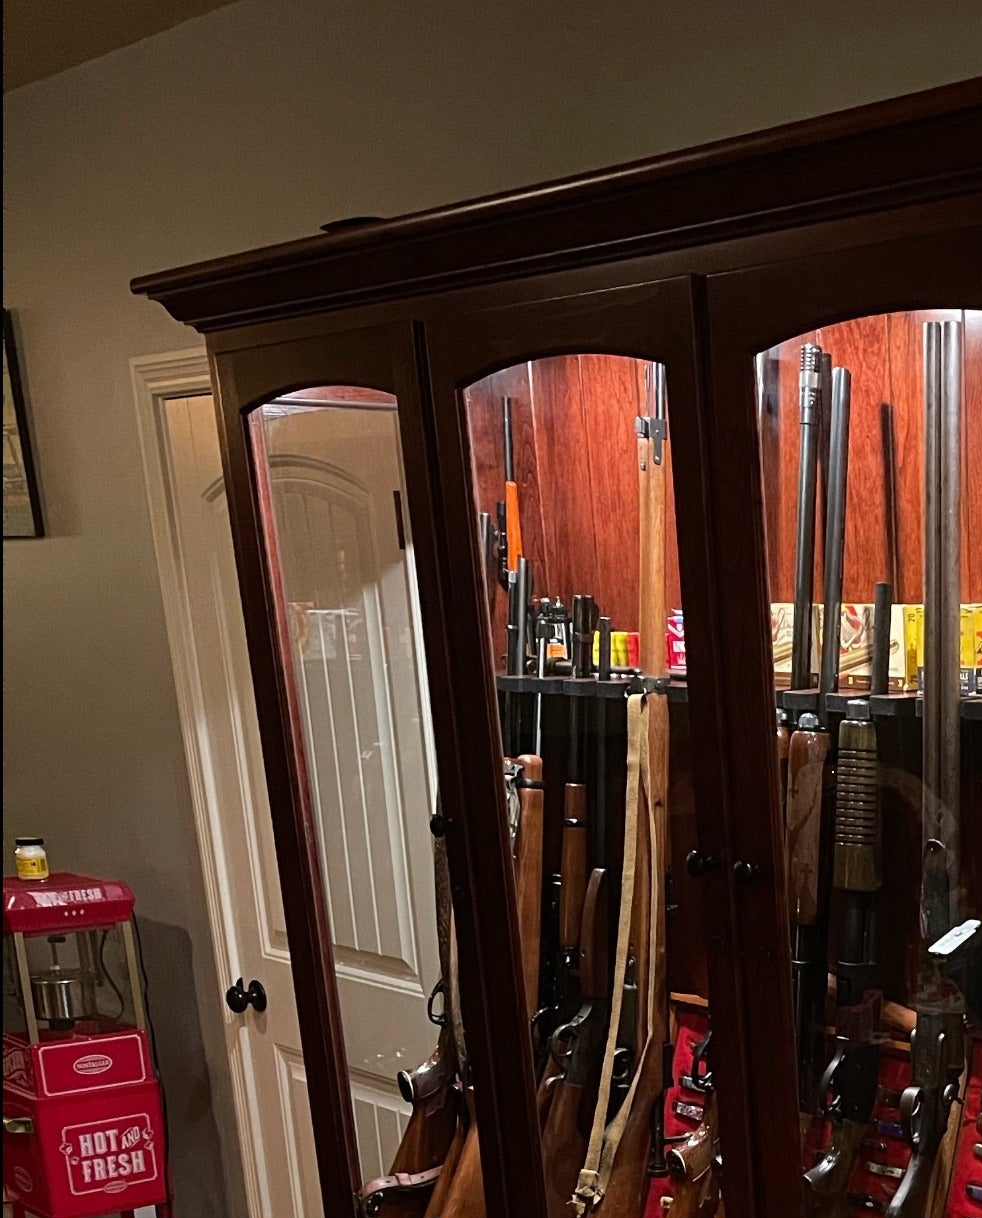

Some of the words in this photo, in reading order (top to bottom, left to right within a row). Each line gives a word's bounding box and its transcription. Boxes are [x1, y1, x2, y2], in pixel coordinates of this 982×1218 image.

[68, 887, 102, 902] FRESH
[79, 1129, 119, 1157] HOT
[121, 1126, 141, 1149] AND
[81, 1150, 146, 1183] FRESH
